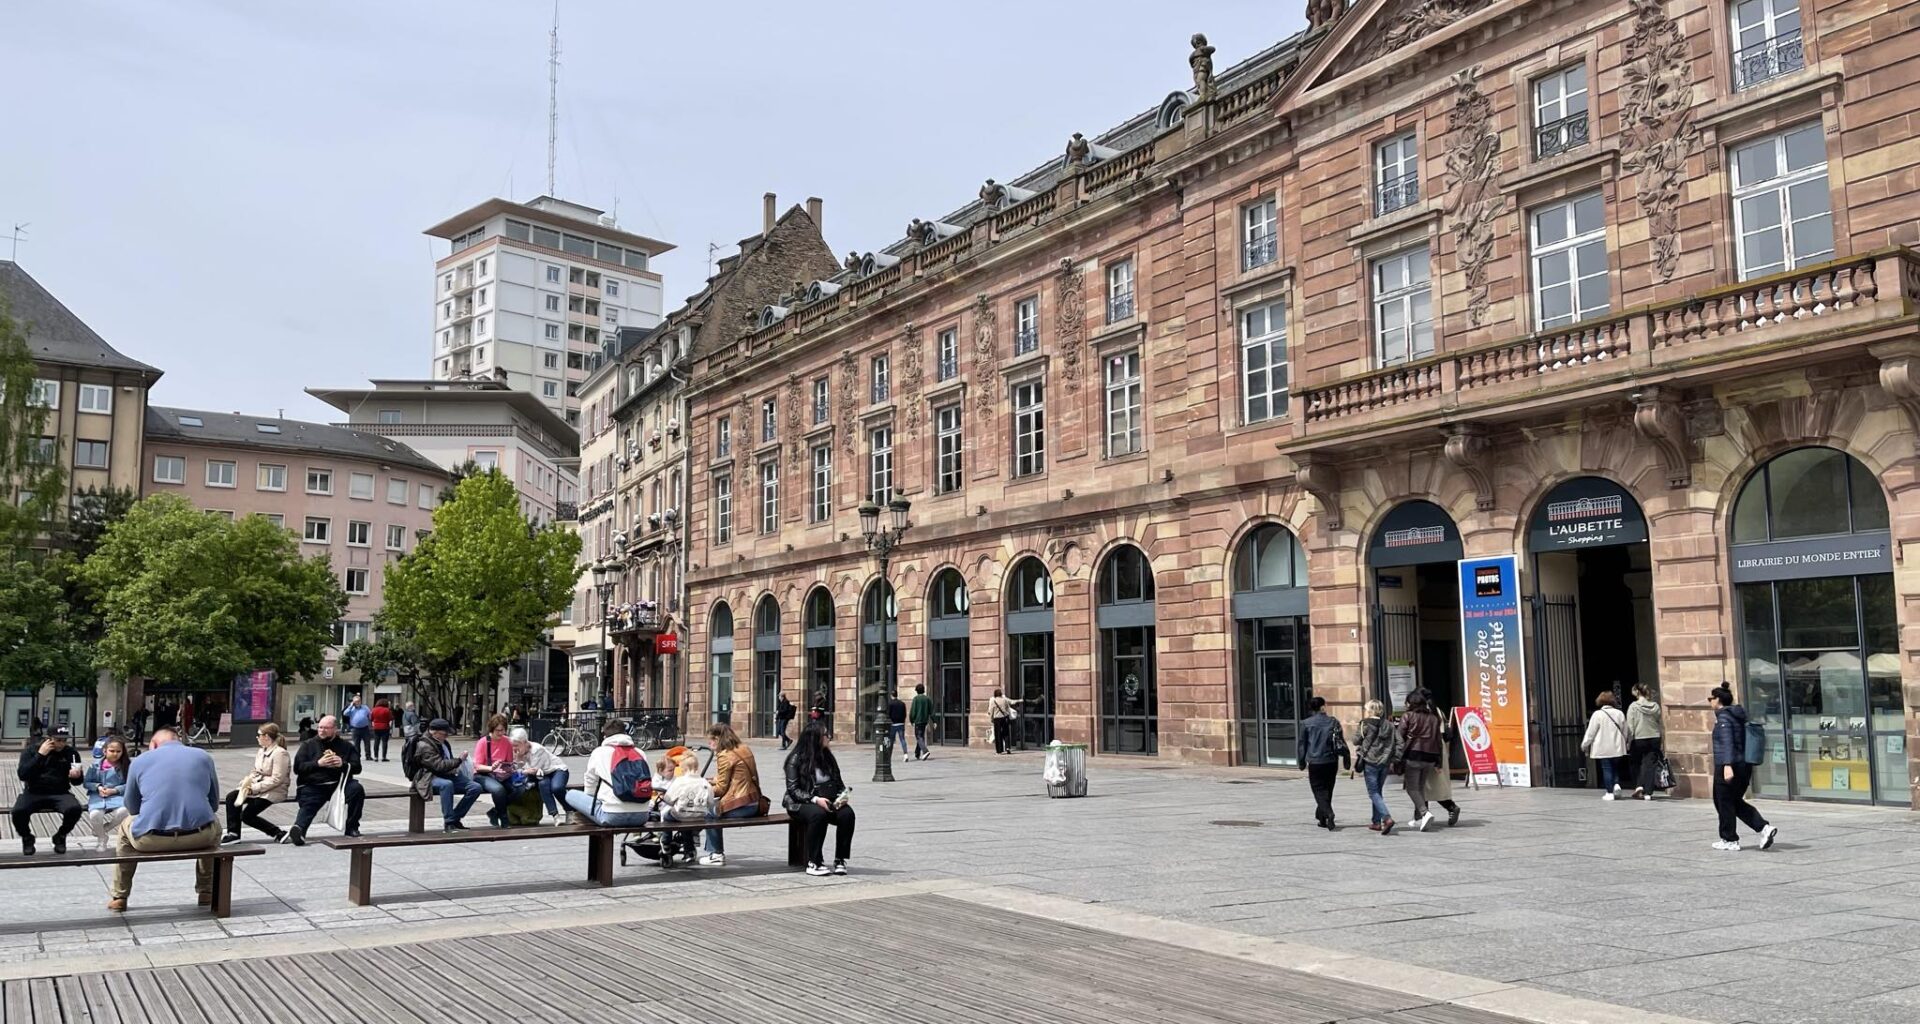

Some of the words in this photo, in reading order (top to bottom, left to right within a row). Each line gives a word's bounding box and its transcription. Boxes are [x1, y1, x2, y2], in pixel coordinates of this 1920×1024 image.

[1549, 518, 1622, 535] L'AUBETTE
[1568, 534, 1603, 543] Shopping
[1737, 557, 1784, 568] LIBRAIRIE
[1785, 556, 1800, 565] DU
[1802, 552, 1841, 564] MONDE
[1843, 549, 1881, 560] ENTIER
[1477, 574, 1500, 584] PHOTOS
[1475, 629, 1489, 668] rêve
[1489, 621, 1507, 686] réalité
[1495, 688, 1509, 707] et
